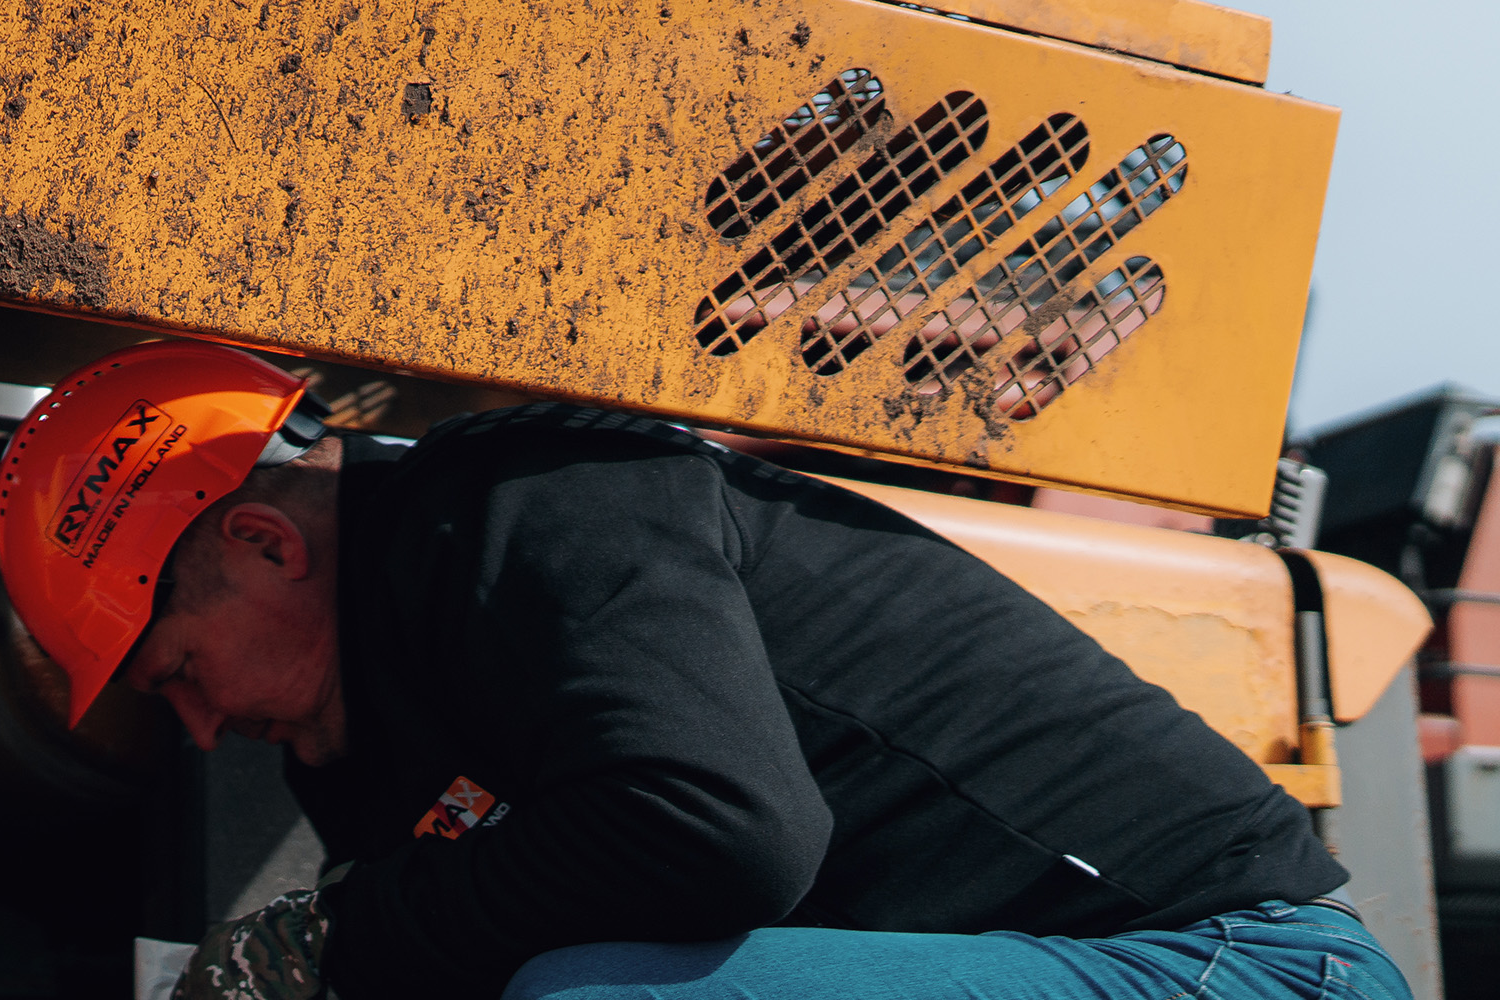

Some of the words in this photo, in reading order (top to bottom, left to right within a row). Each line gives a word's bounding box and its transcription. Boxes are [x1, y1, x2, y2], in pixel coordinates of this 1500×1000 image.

[55, 406, 160, 545] RYMAX
[82, 519, 117, 569] MADE
[112, 499, 130, 518] IN
[125, 424, 188, 498] HOLLAND
